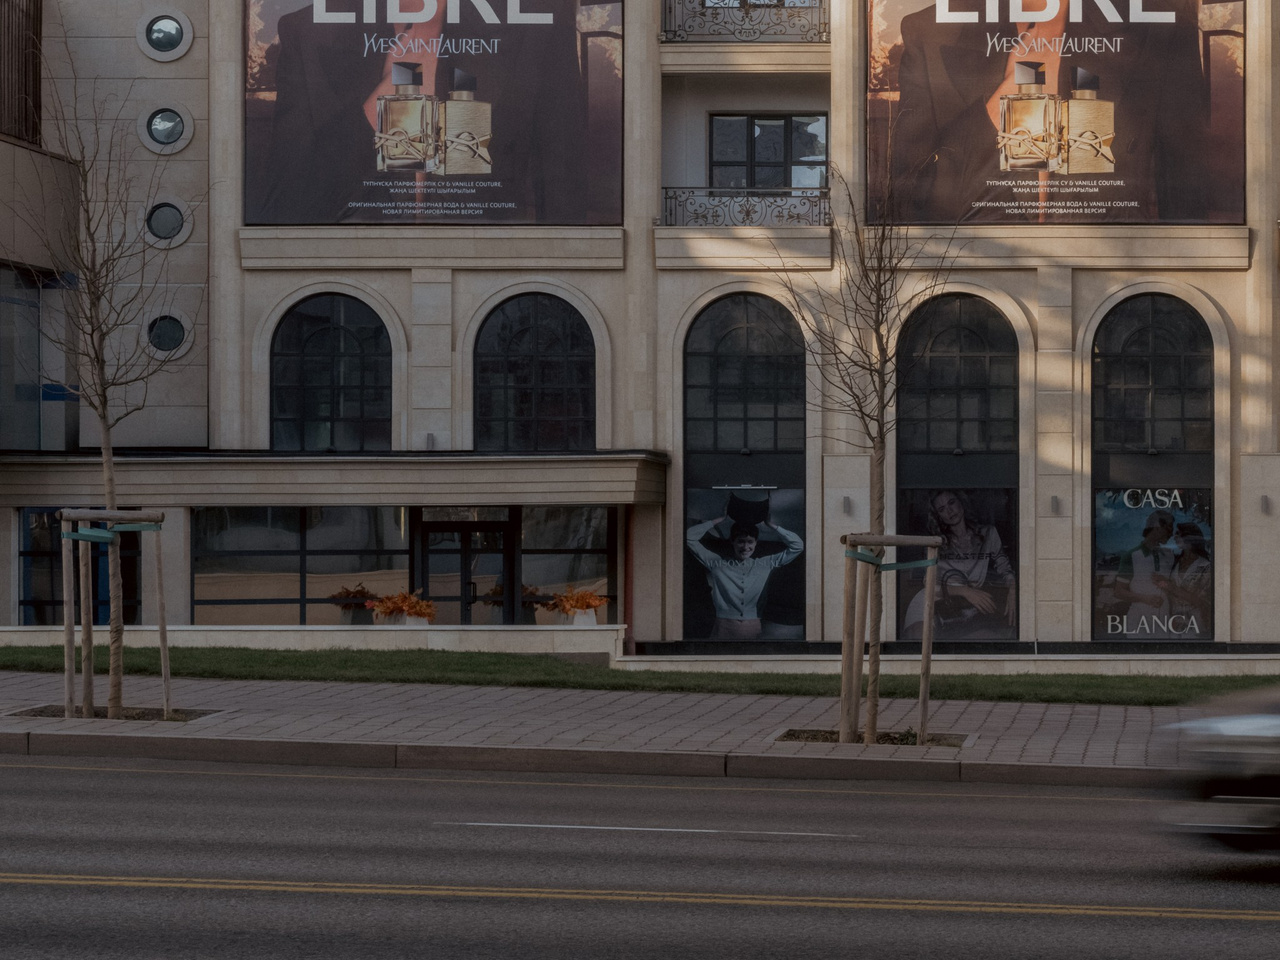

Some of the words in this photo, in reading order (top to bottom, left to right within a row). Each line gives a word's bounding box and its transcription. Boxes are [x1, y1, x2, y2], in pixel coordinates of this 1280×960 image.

[1123, 488, 1184, 510] CASA
[705, 559, 741, 567] MAISON
[1106, 614, 1200, 635] BLANCA
